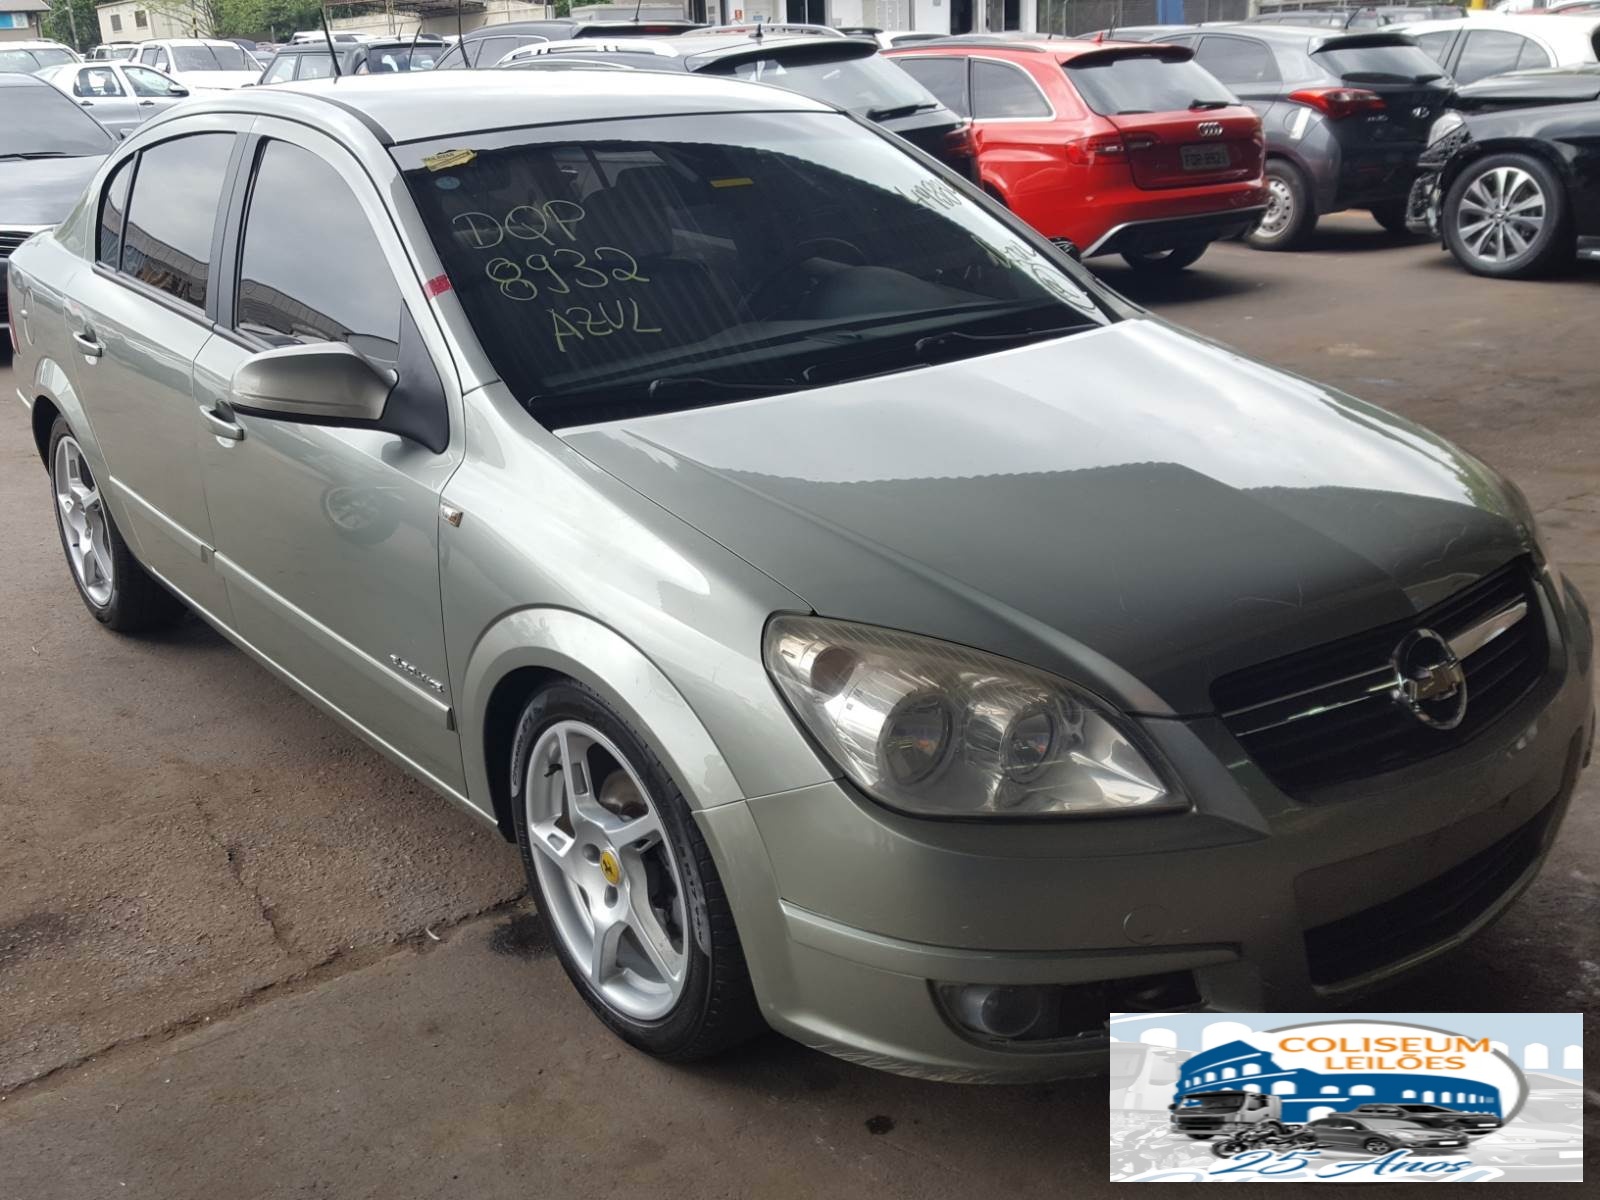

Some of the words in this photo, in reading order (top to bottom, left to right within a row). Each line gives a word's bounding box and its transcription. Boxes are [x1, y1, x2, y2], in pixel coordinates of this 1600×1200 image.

[452, 200, 585, 249] DQP
[486, 247, 650, 300] 8932
[547, 297, 662, 352] AZUL
